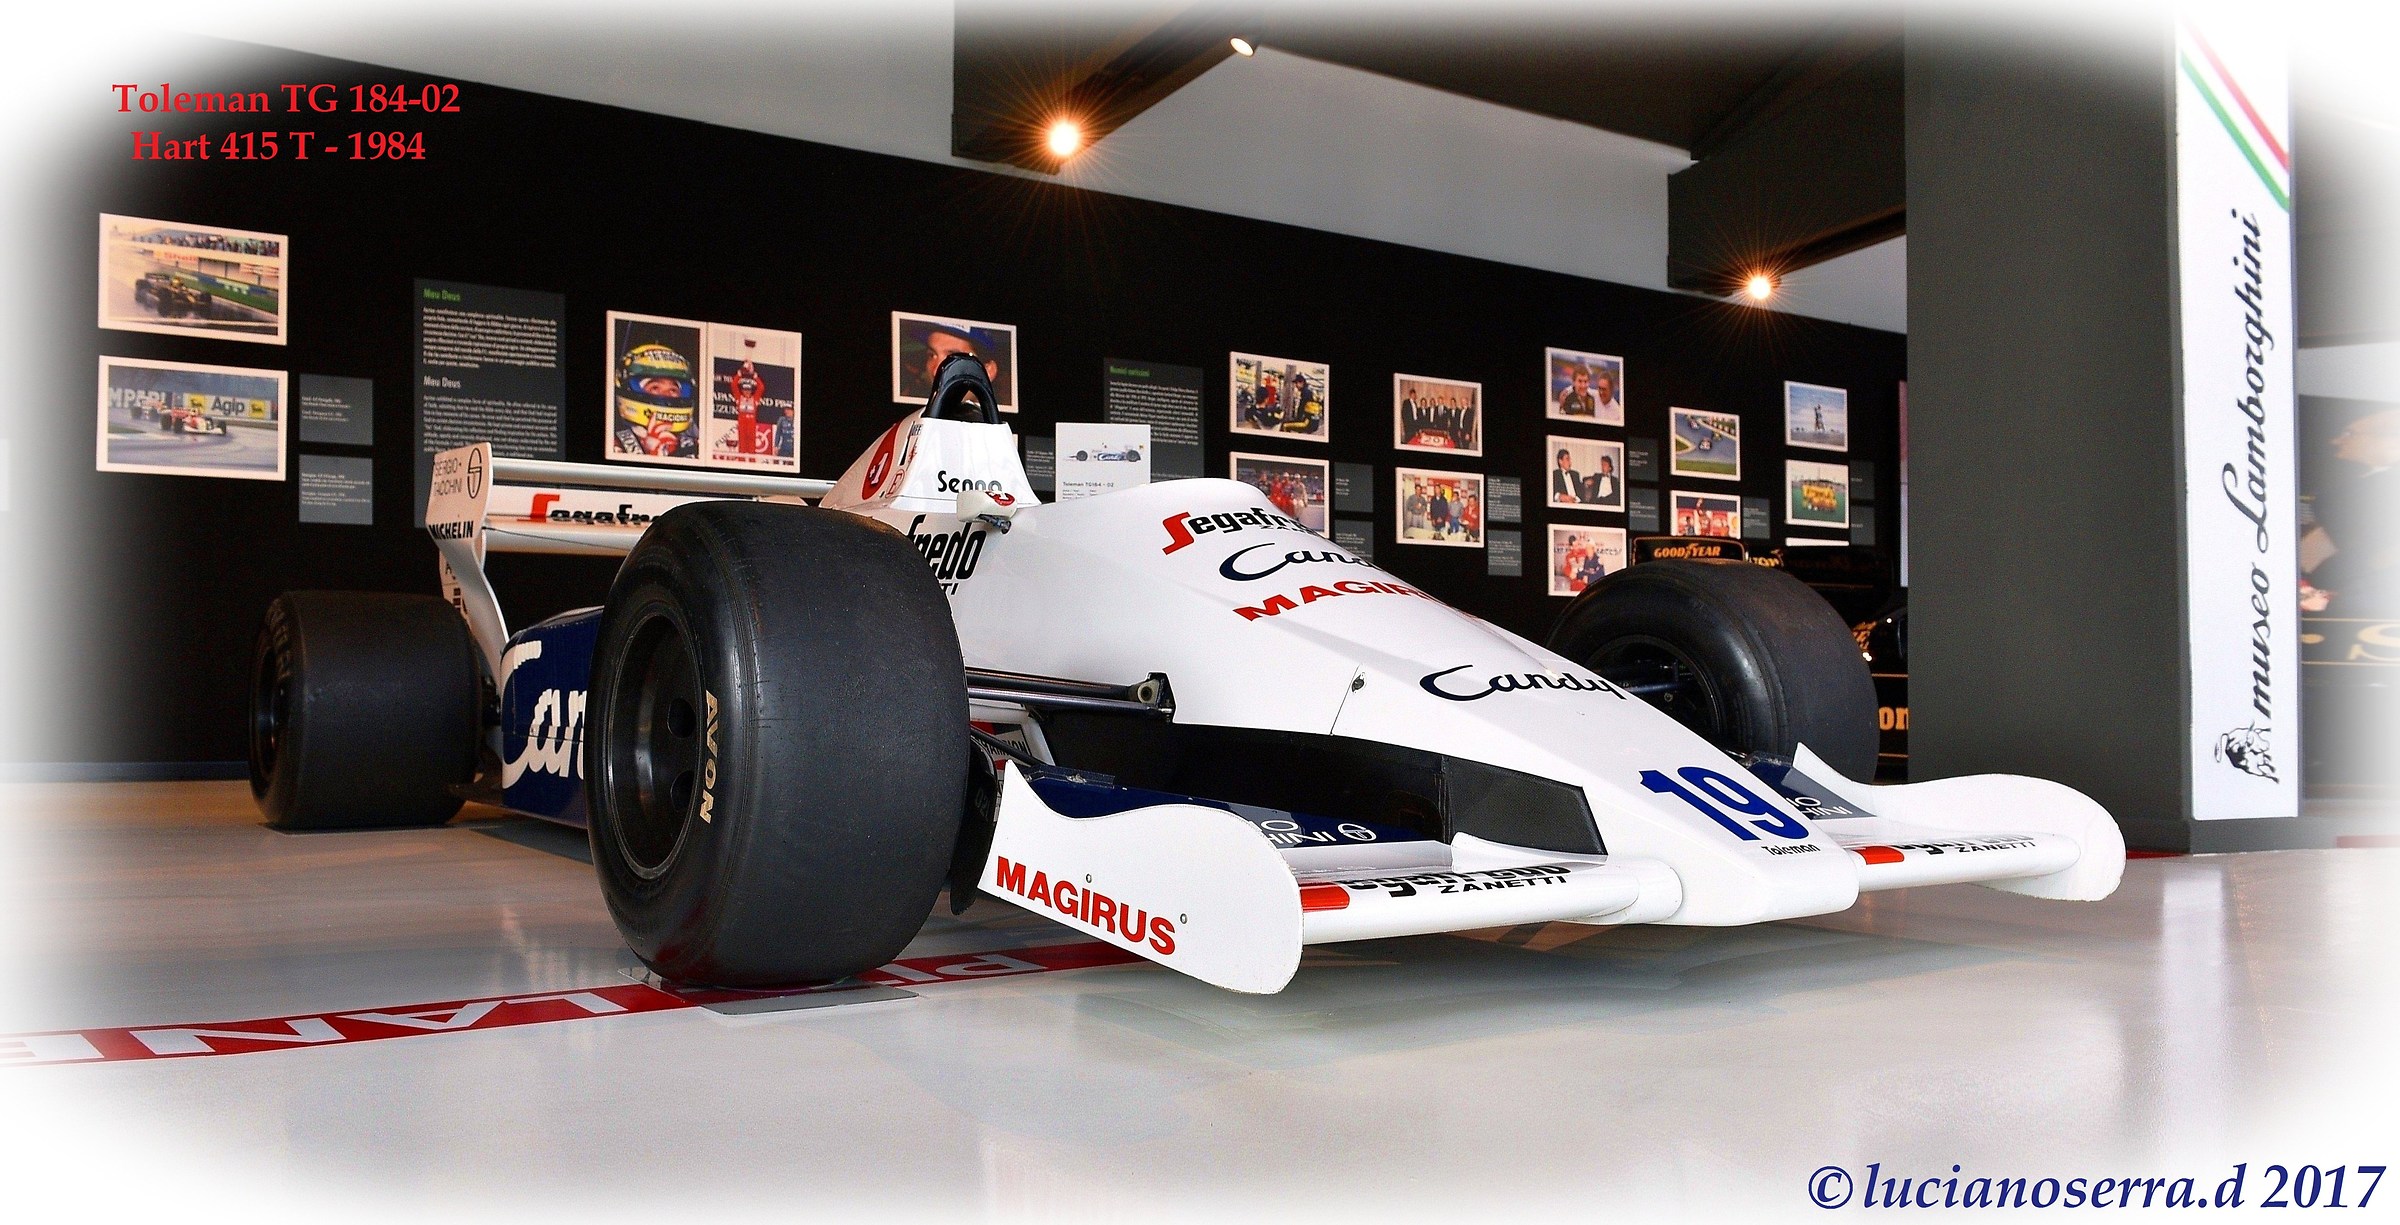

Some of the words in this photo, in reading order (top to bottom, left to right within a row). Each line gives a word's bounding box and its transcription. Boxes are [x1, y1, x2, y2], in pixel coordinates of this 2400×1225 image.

[2222, 206, 2275, 556] Lamborghini
[211, 396, 246, 416] Agip
[428, 521, 475, 541] MICHELIN
[1653, 543, 1722, 560] GOODYEAR
[2248, 560, 2272, 721] museo
[1420, 664, 1628, 701] Candy
[699, 689, 719, 824] AVON
[1638, 766, 1810, 841] 19
[1760, 842, 1822, 857] Toleman
[1957, 841, 2038, 853] ZANETTI
[1440, 875, 1568, 895] ZANETTI
[996, 855, 1176, 956] MAGIRUS
